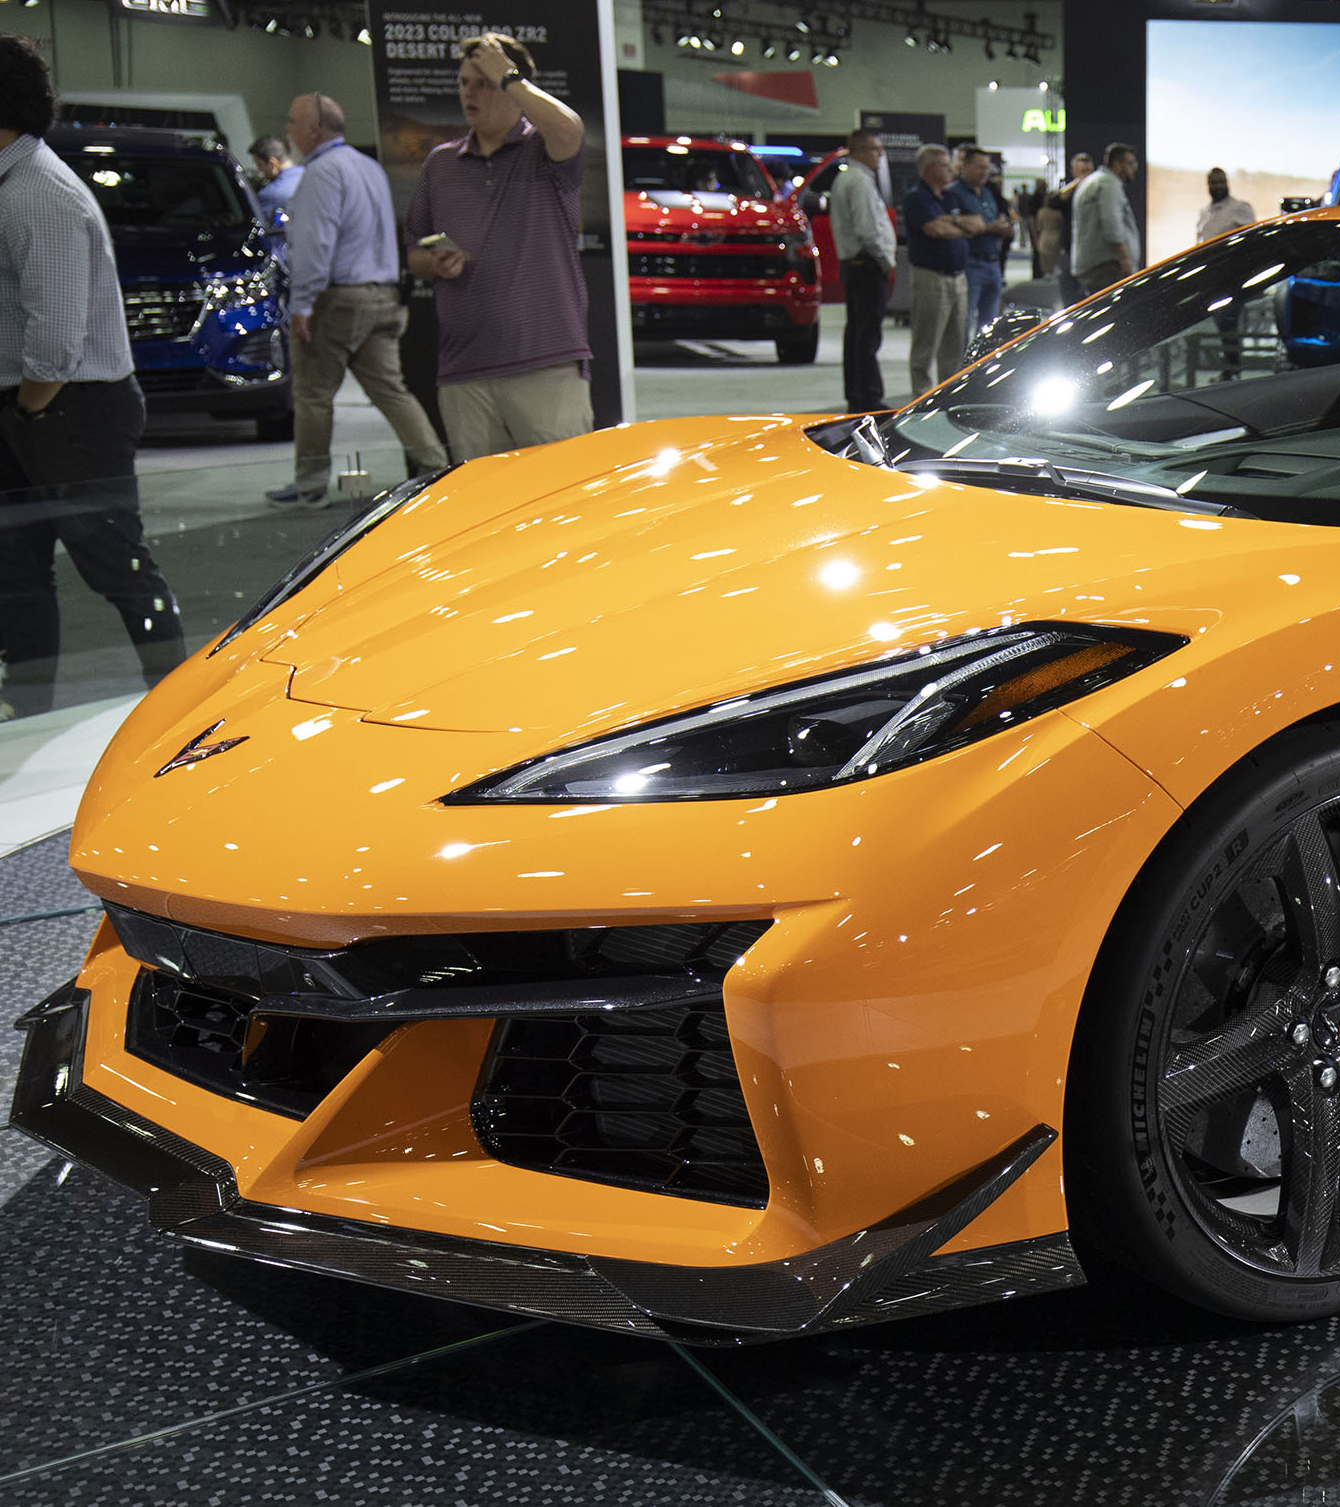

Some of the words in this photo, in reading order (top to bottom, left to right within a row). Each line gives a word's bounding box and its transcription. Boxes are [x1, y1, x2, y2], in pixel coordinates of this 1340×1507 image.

[384, 23, 425, 40] 2023
[515, 27, 547, 43] ZR2
[386, 42, 446, 59] DESERT
[1133, 1014, 1153, 1154] MICHELIN
